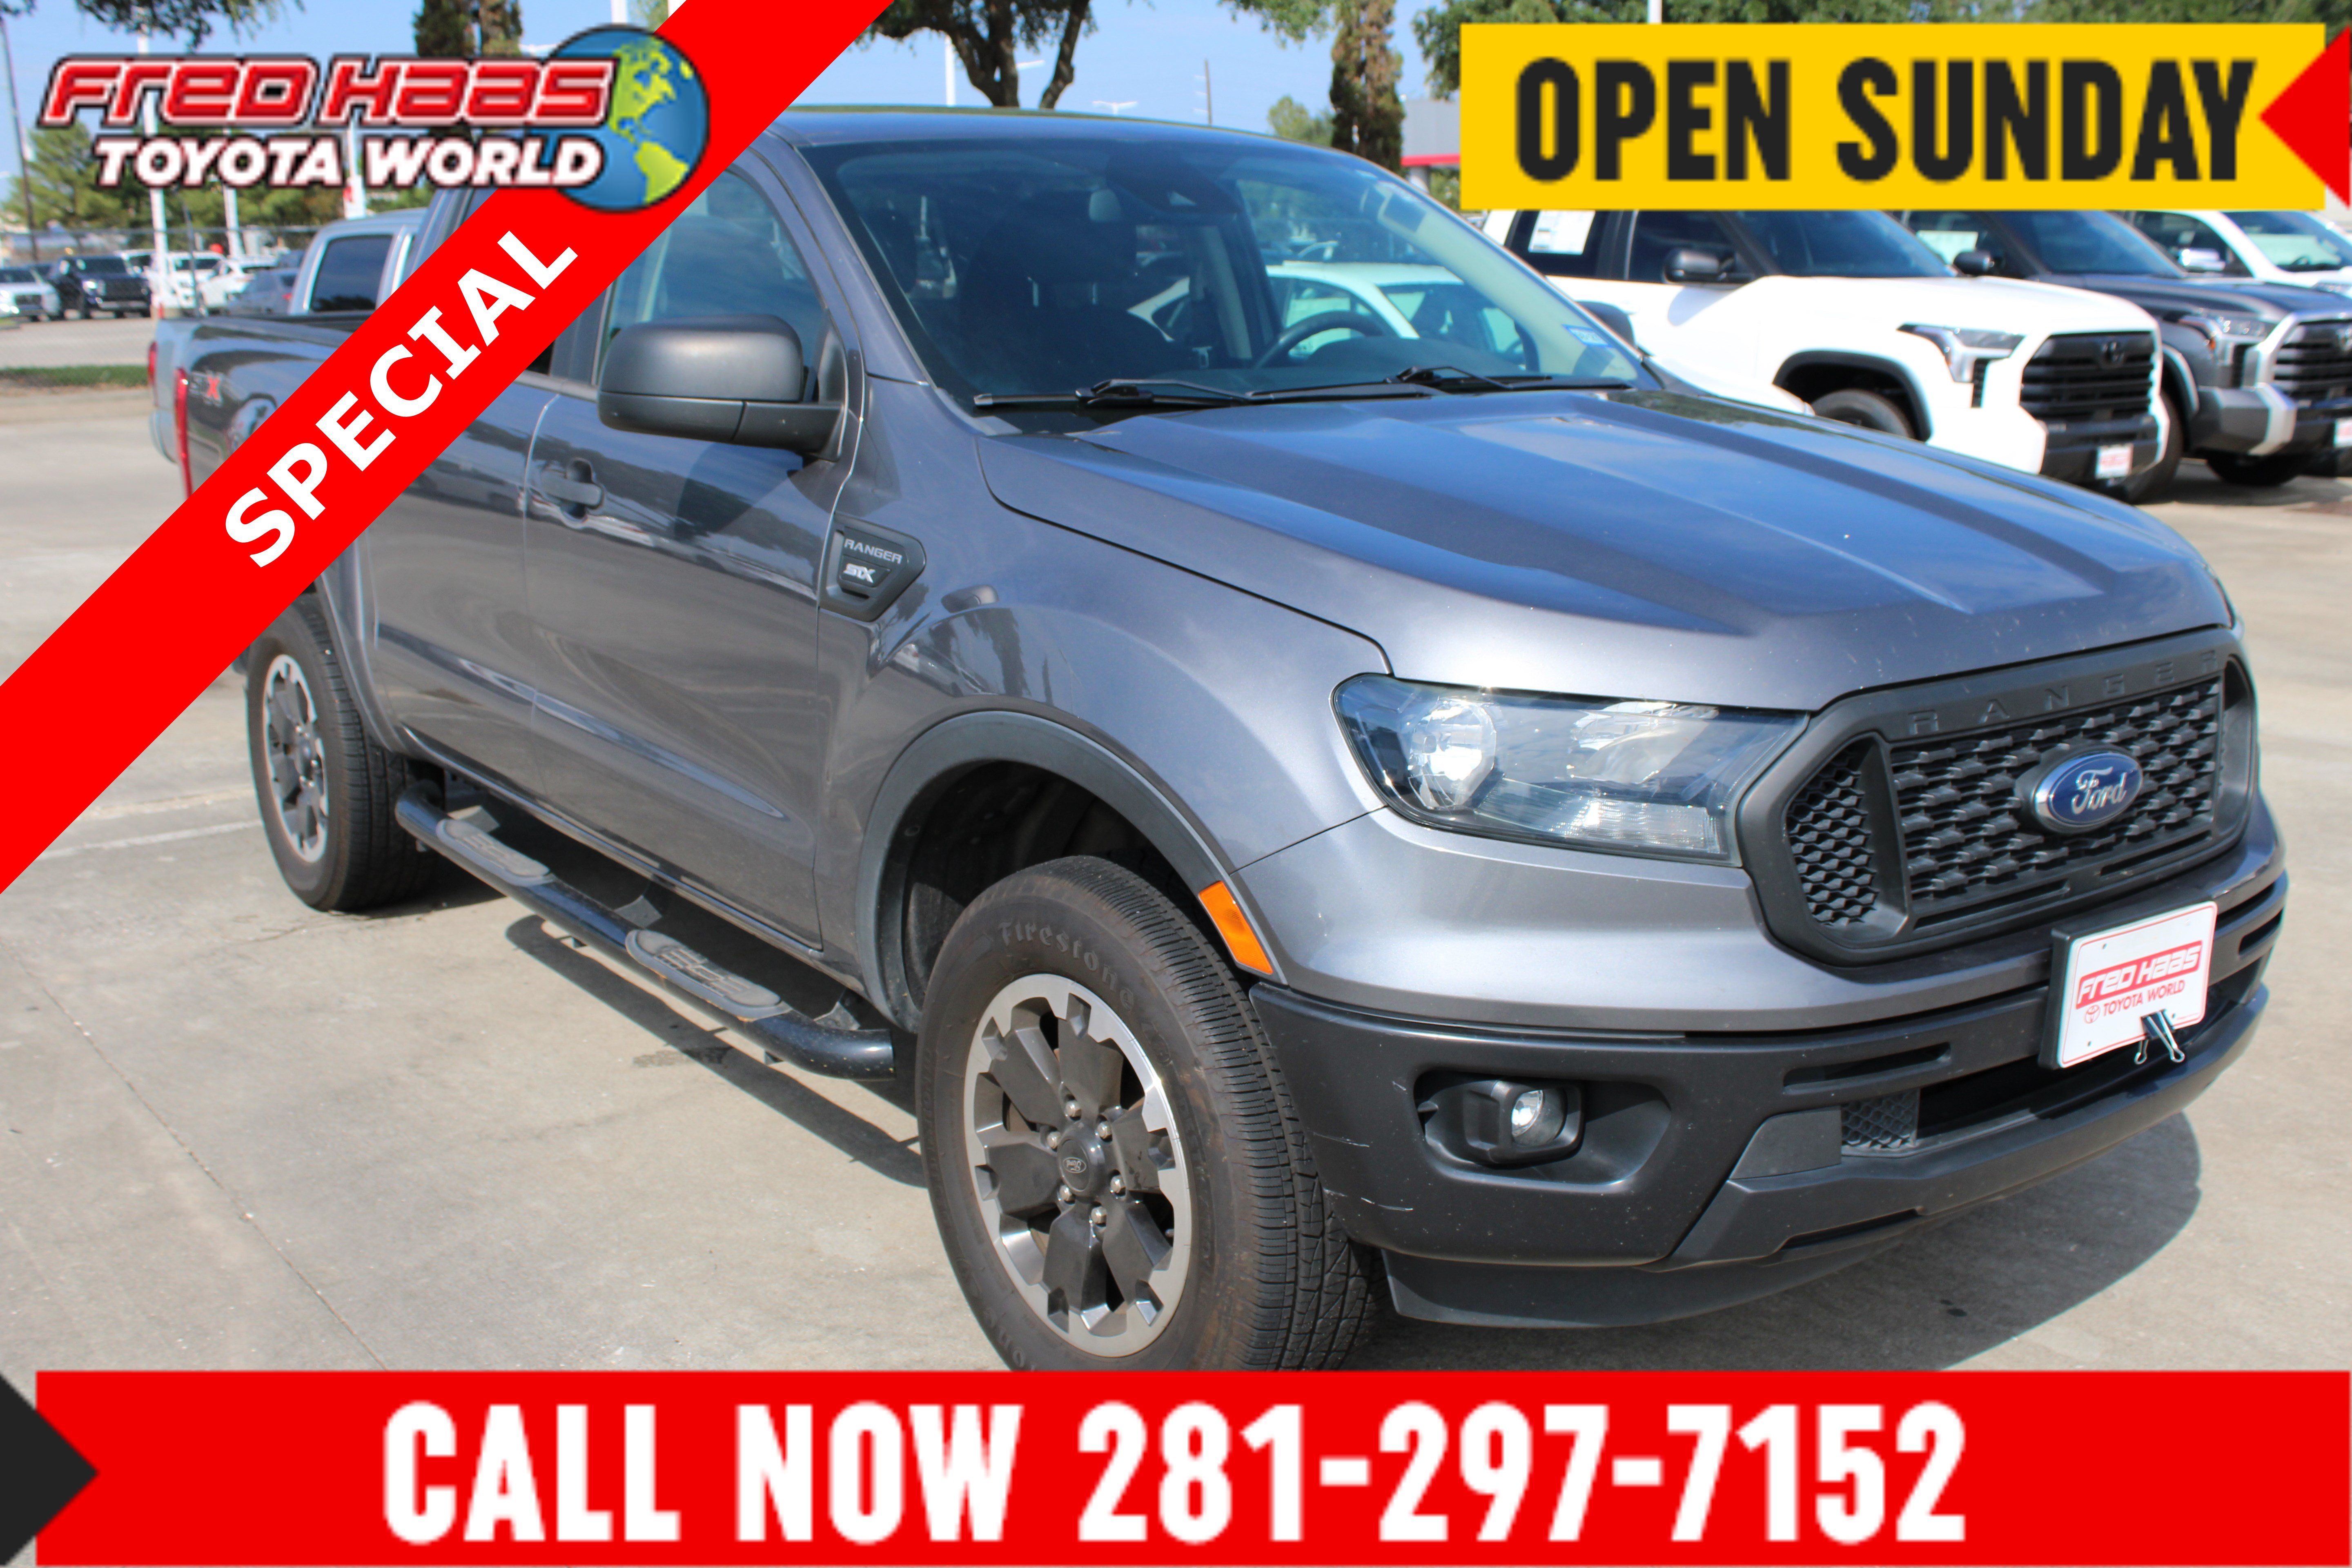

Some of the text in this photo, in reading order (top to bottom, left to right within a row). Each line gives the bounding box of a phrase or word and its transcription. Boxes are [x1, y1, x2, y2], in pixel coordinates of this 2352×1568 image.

[844, 539, 902, 564] RANGER
[843, 563, 875, 583] STX
[1908, 649, 2218, 735] RANGER
[2071, 766, 2127, 814] Ford
[998, 921, 1134, 1011] Firestone
[2103, 980, 2185, 1016] TOYOTA WORLD
